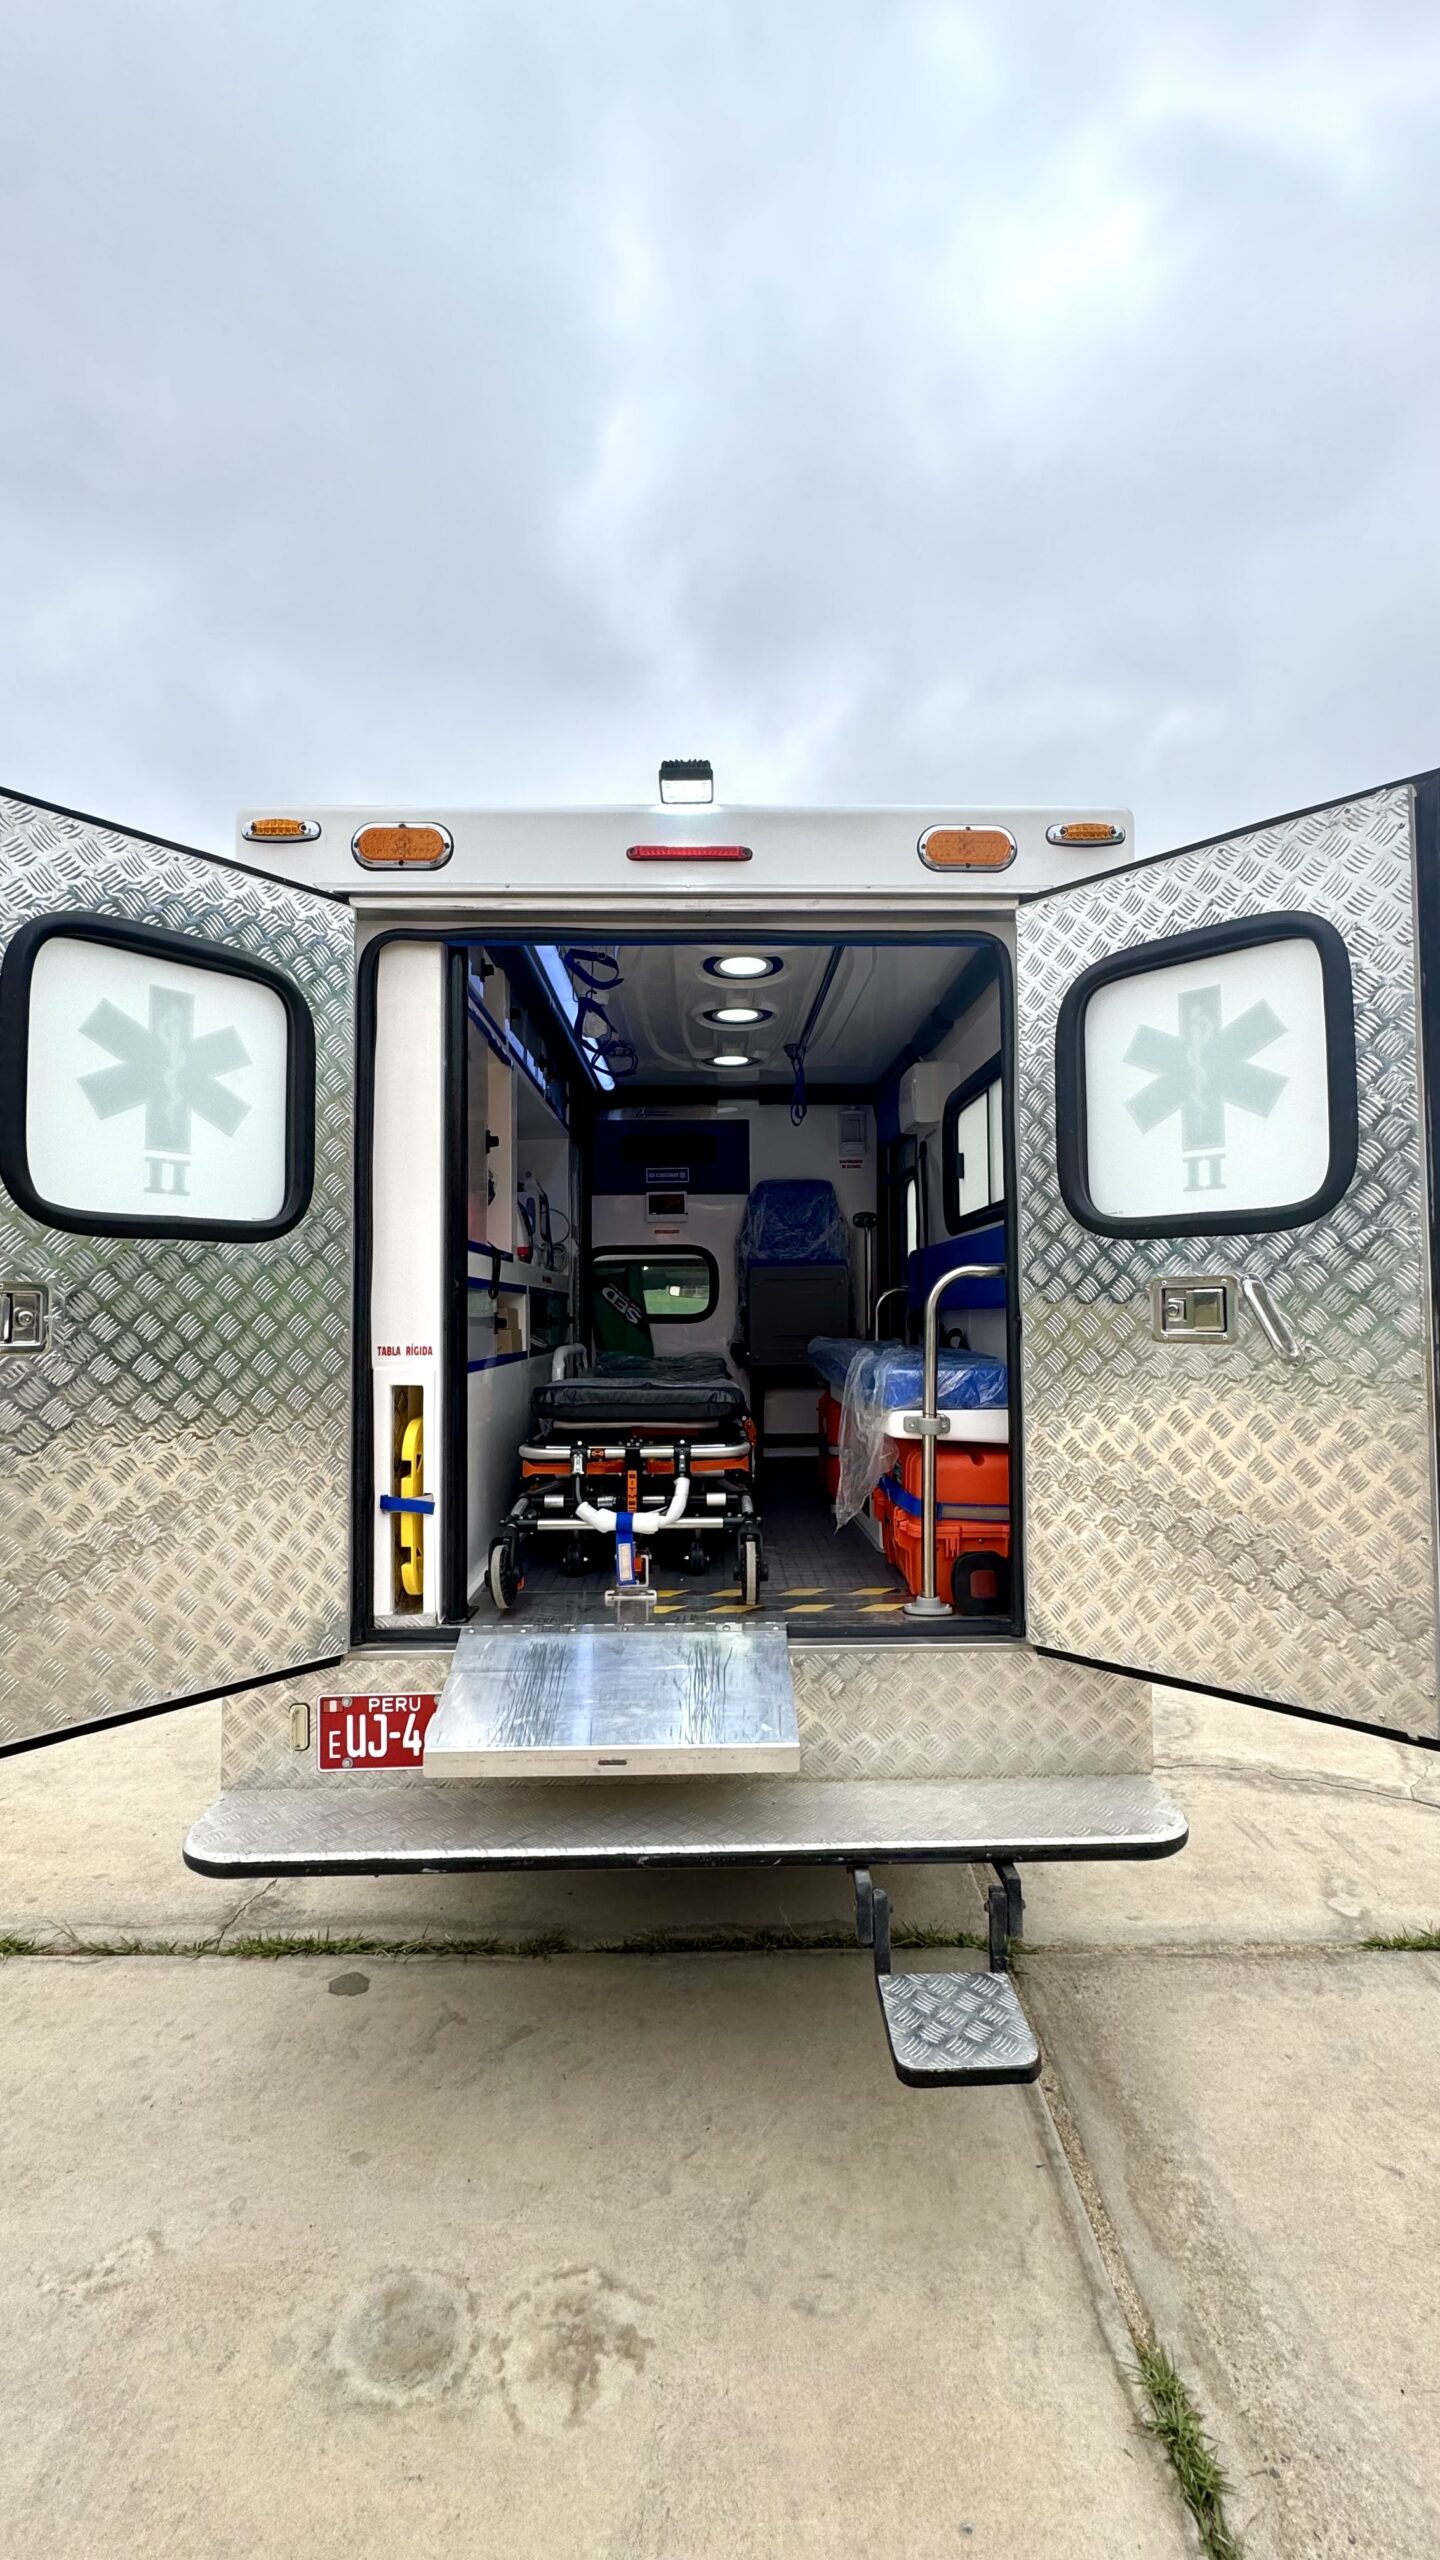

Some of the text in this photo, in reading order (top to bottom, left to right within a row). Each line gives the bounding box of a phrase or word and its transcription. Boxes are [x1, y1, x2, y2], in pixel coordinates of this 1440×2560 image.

[377, 1343, 433, 1356] TABLA RÍGIDA
[368, 1697, 421, 1713] PERU
[329, 1713, 422, 1759] EUJ-4
